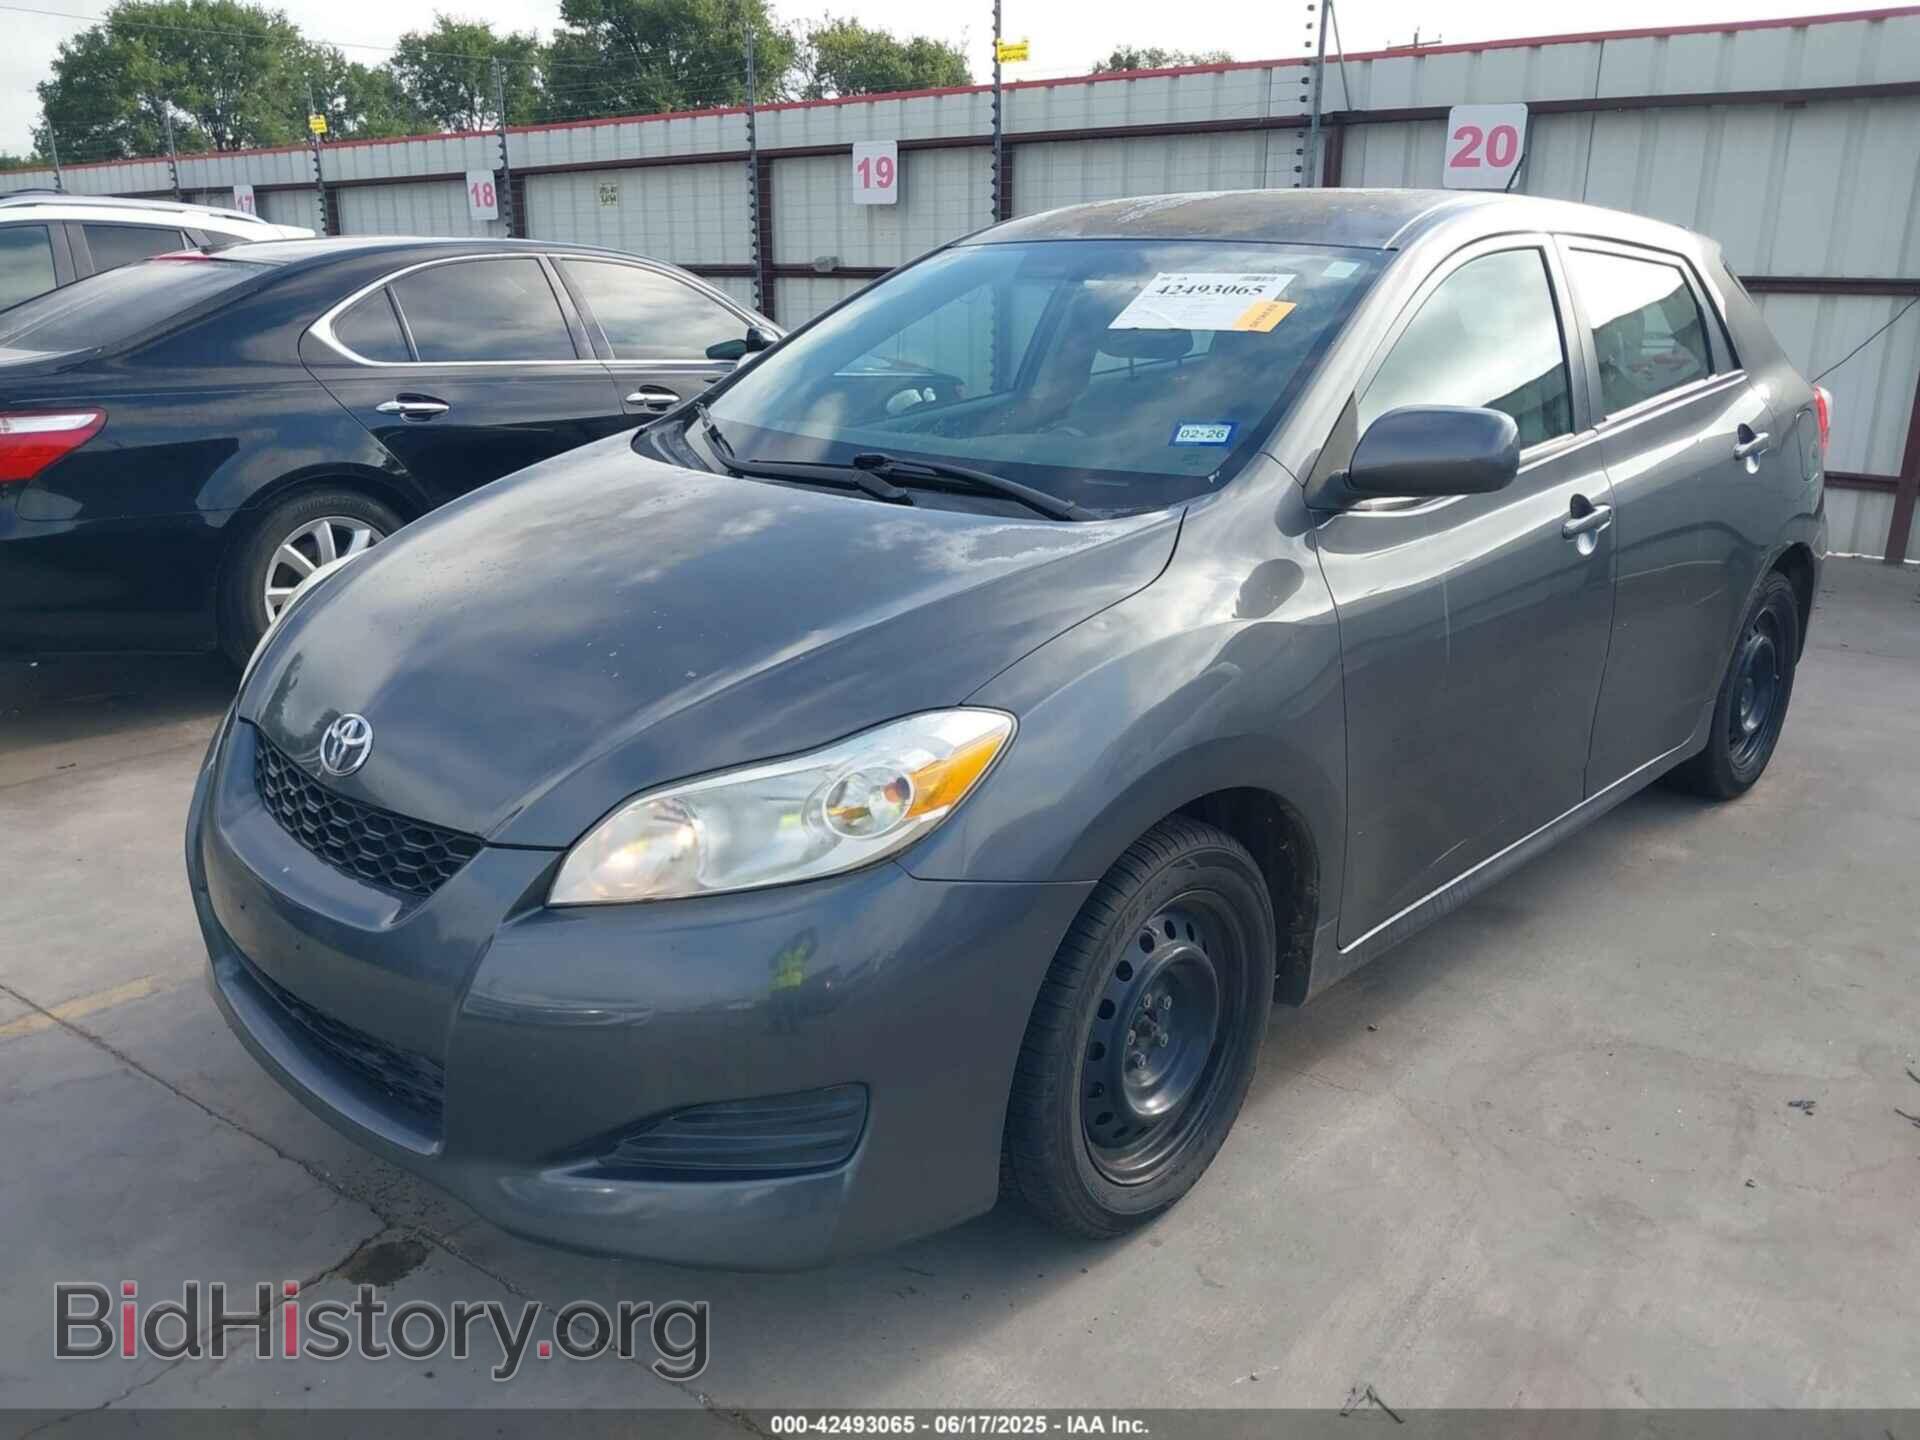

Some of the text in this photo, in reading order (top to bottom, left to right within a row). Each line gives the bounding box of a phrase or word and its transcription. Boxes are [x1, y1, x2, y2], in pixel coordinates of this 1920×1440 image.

[1449, 124, 1518, 168] 20
[857, 156, 895, 189] 19
[471, 181, 496, 208] 18
[1155, 283, 1267, 297] 42493065
